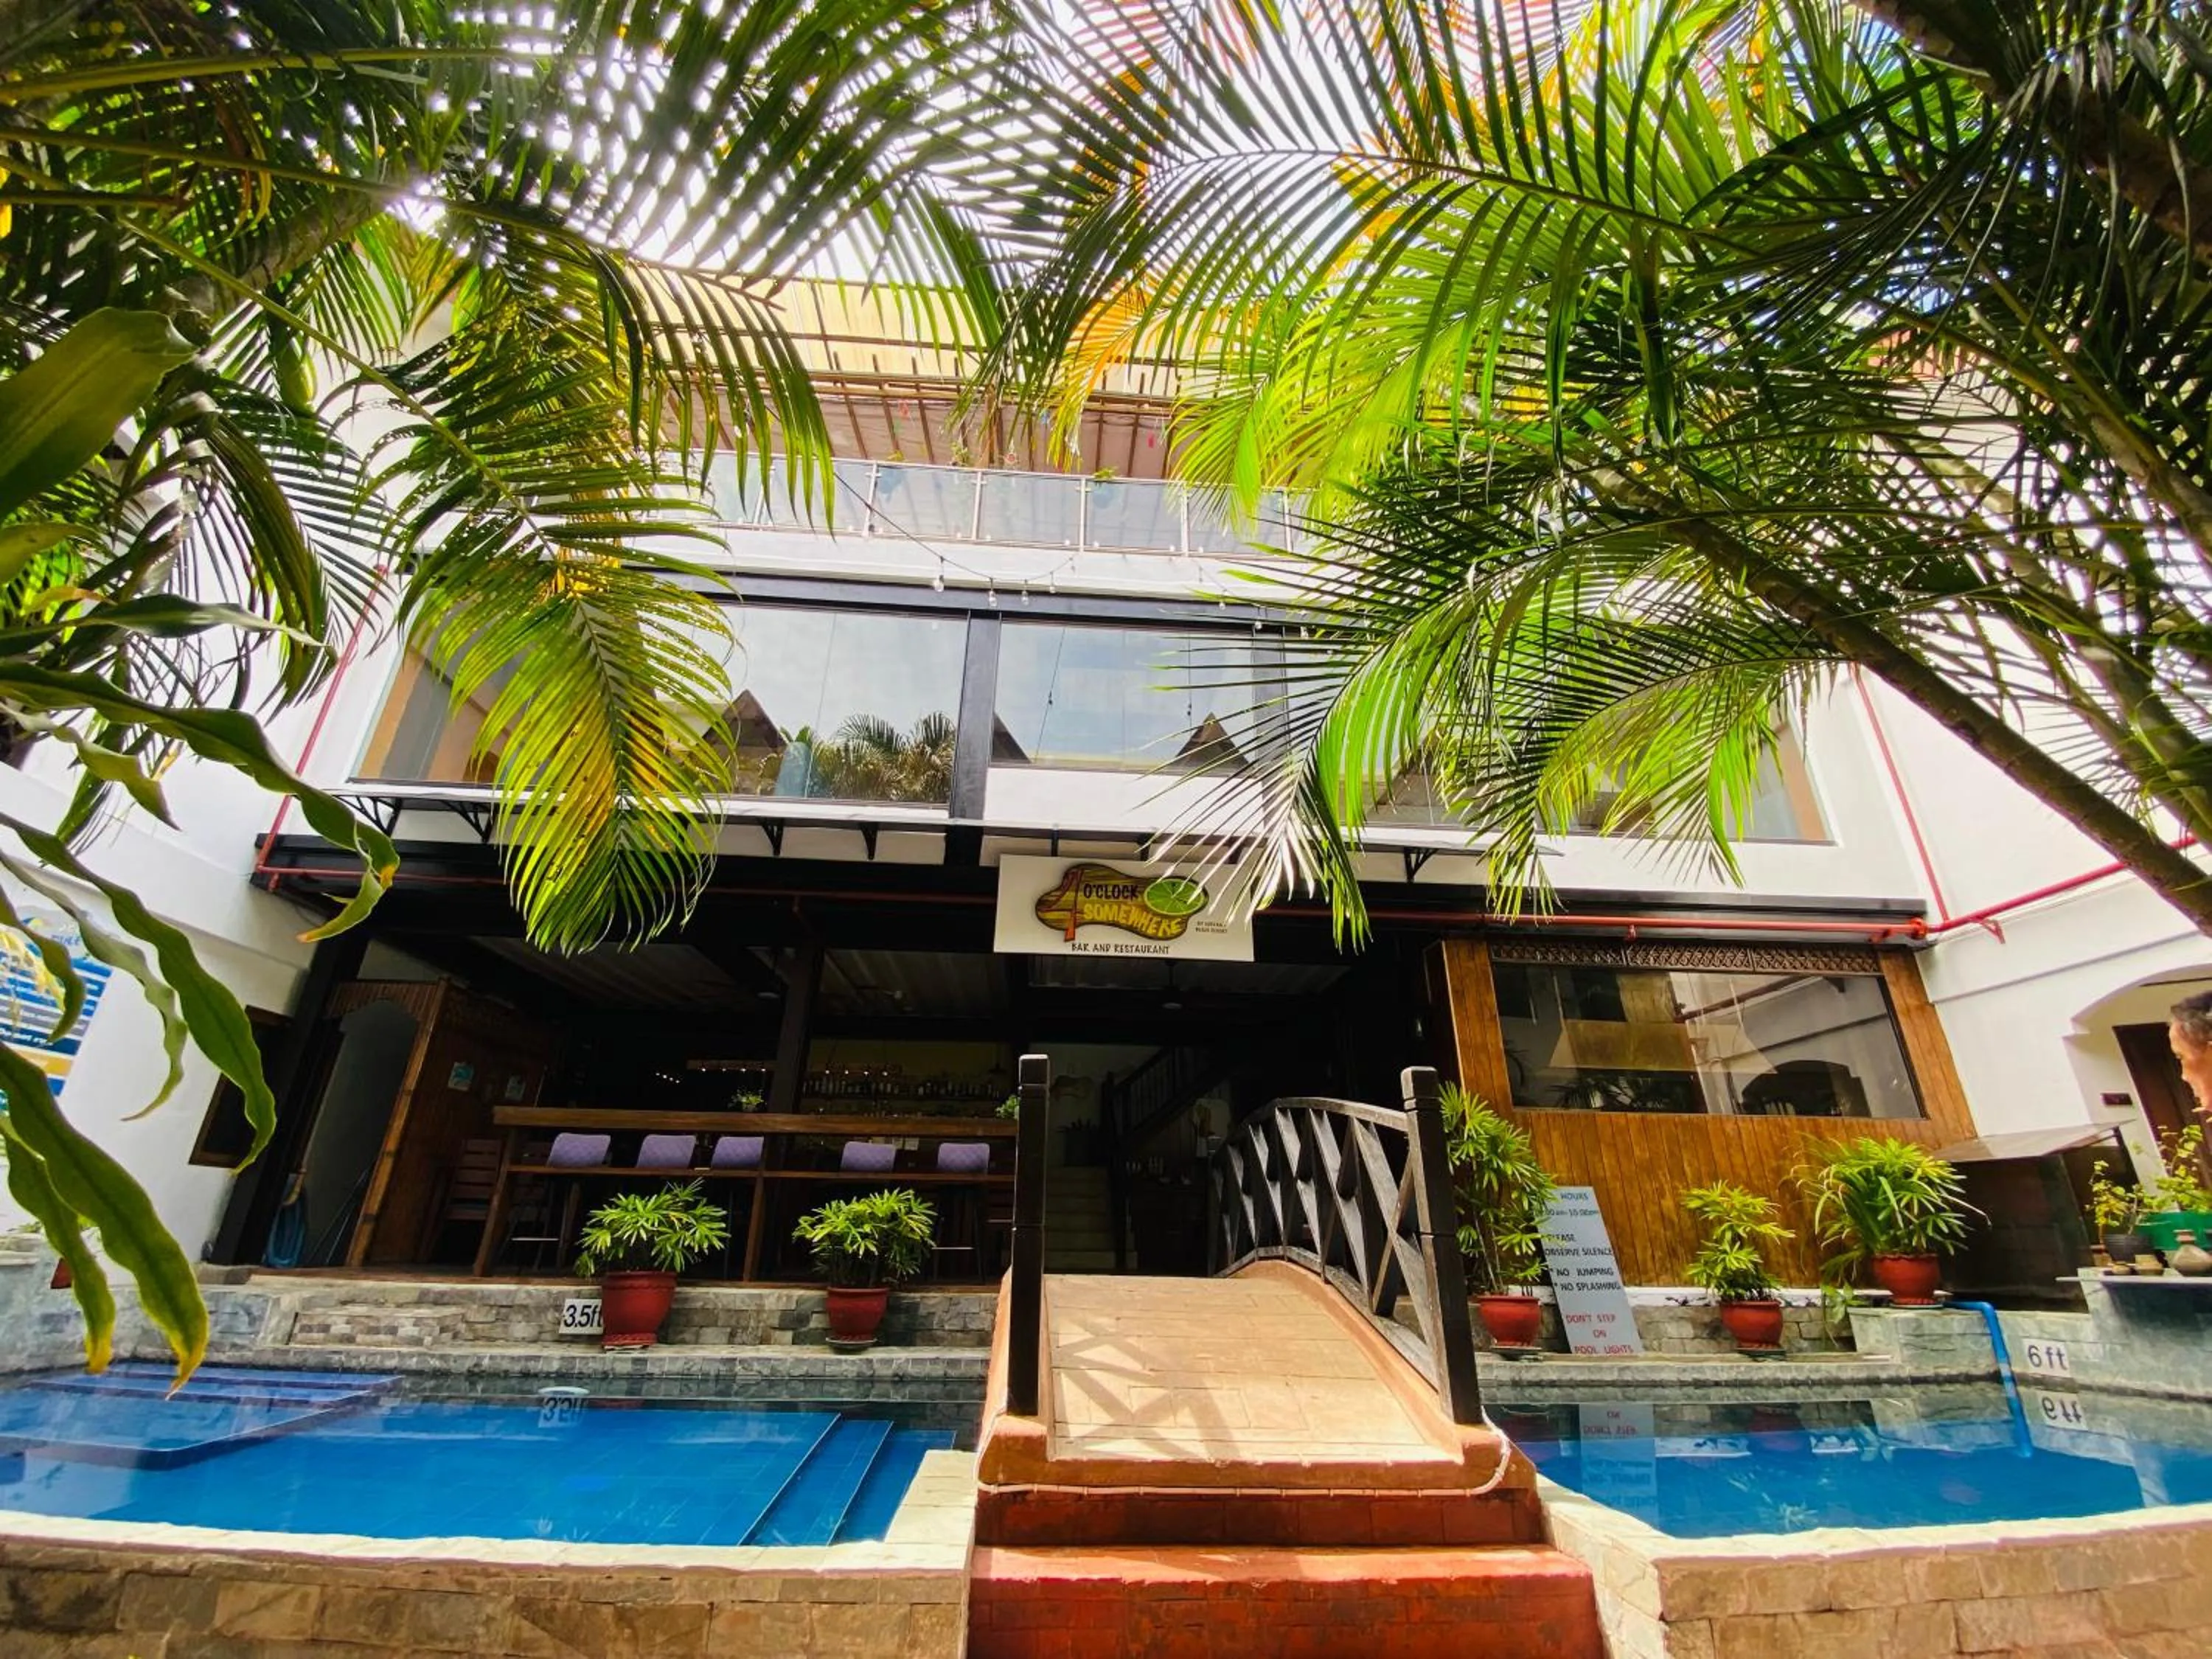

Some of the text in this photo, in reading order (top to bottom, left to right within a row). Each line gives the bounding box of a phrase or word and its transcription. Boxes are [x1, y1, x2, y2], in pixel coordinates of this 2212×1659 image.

[1082, 883, 1140, 900] O'CLOCK
[1082, 902, 1183, 937] SOMEWHERE
[1071, 943, 1171, 955] BAR AND RESTAURANT
[1560, 1192, 1589, 1200] HOURS
[1557, 1267, 1614, 1276] NO JUMPING
[1560, 1281, 1621, 1291] NO SPLASHING
[1565, 1313, 1616, 1324] DON'T STEP
[1593, 1329, 1607, 1338] ON
[1574, 1345, 1634, 1354] POOL LIGHTS
[2028, 1344, 2068, 1371] 6ft
